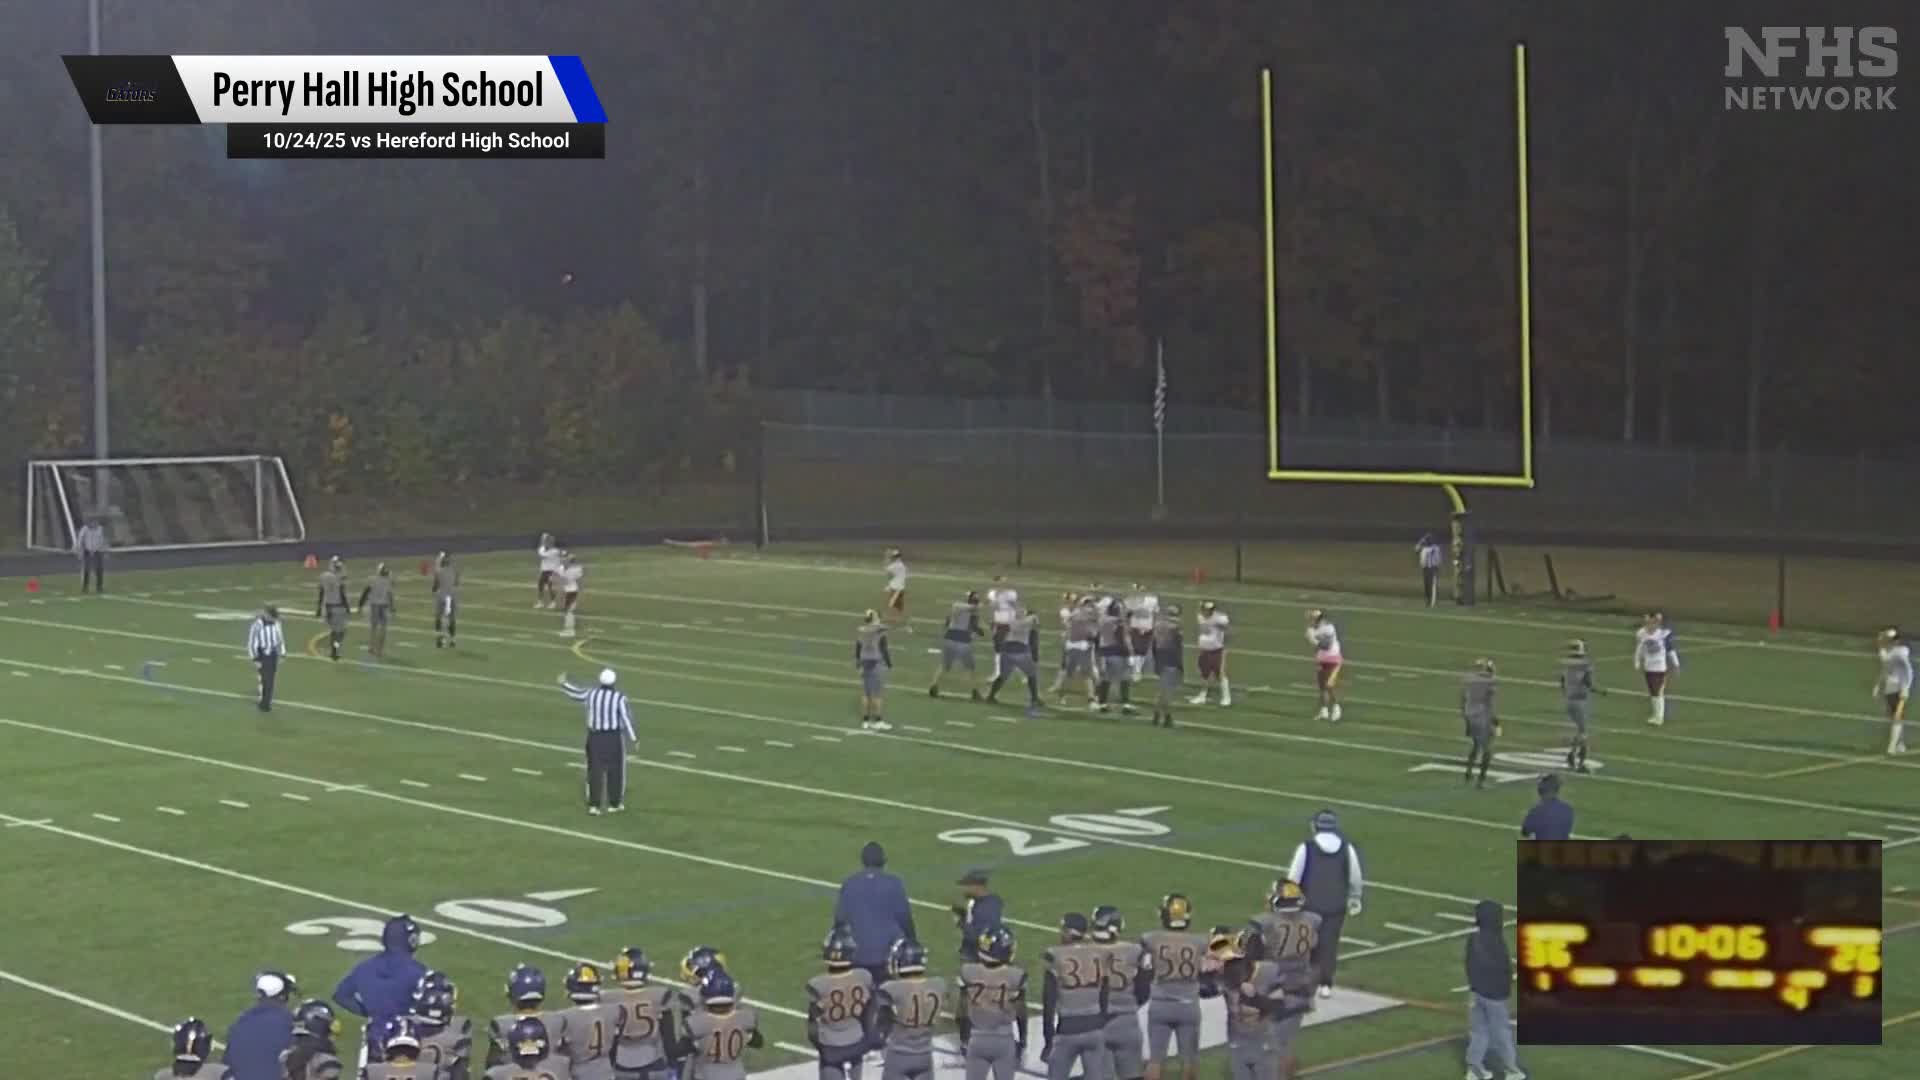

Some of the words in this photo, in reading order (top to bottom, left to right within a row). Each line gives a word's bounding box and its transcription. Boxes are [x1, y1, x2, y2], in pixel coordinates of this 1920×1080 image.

[937, 813, 1172, 857] 20
[1651, 925, 1768, 960] 10:06
[1157, 944, 1197, 979] 58
[829, 986, 866, 1023] 88
